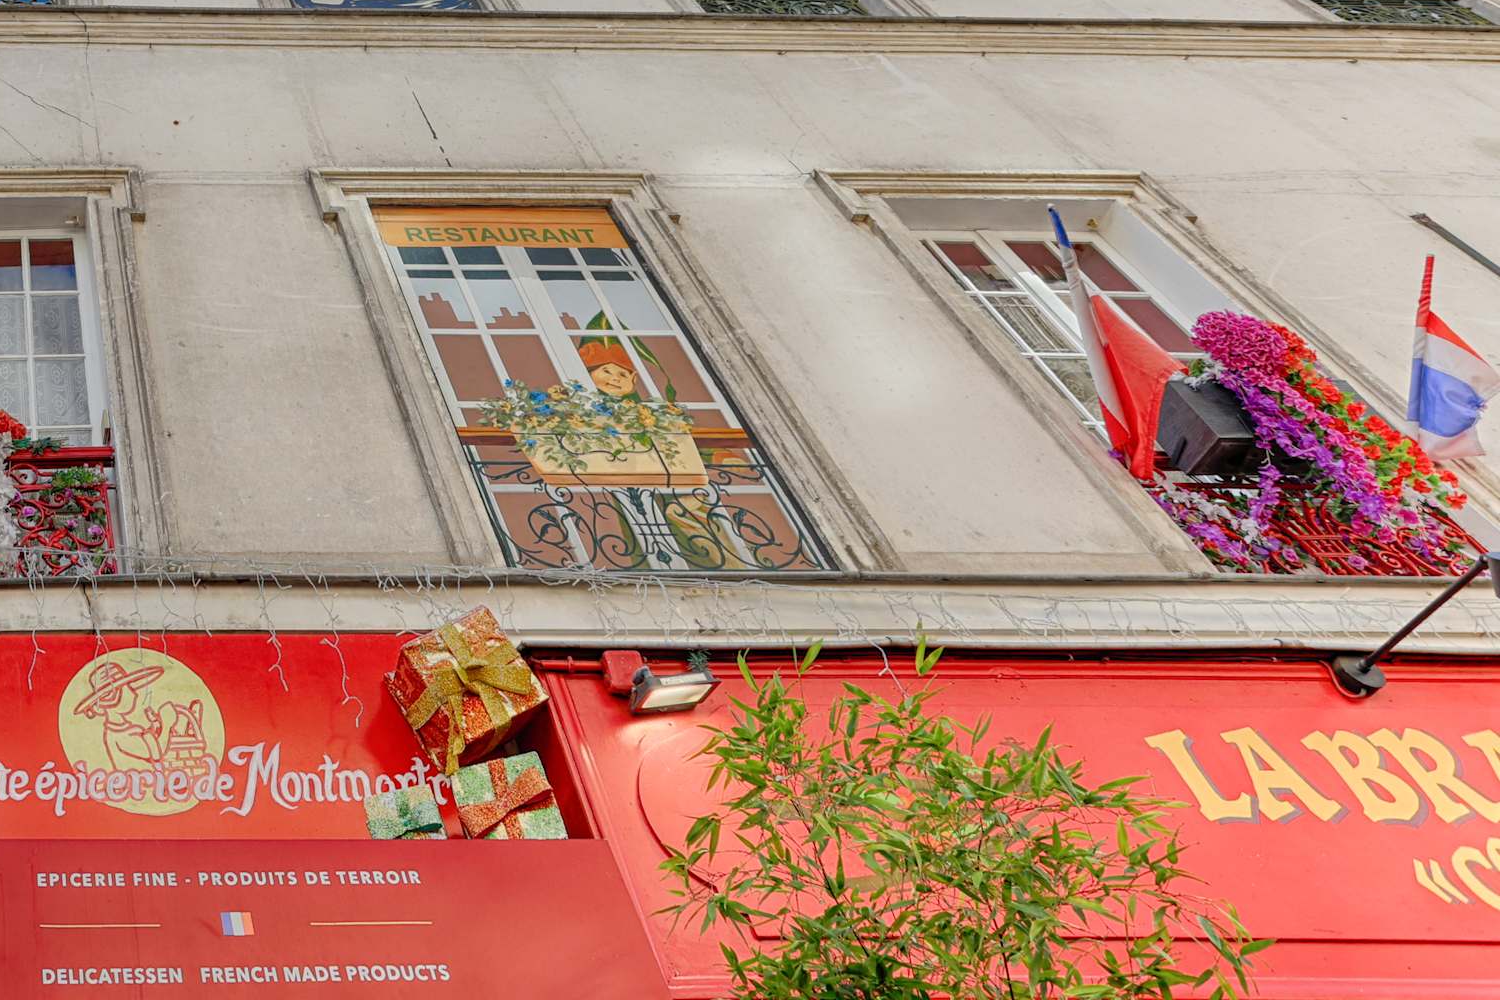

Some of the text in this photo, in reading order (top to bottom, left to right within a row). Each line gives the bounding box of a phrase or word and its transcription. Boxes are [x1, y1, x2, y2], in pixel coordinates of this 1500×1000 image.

[404, 227, 594, 243] RESTAURANT
[34, 761, 189, 817] épicerie
[194, 755, 235, 802] de
[1145, 727, 1348, 824] LA
[36, 872, 126, 888] EPICERIE
[132, 872, 178, 887] FINE
[198, 870, 298, 886] PRODUITS
[304, 870, 331, 885] DE
[335, 869, 421, 885] TERROIR
[41, 964, 451, 985] DELICATESSEN FRENCH MADE PRODUCTS
